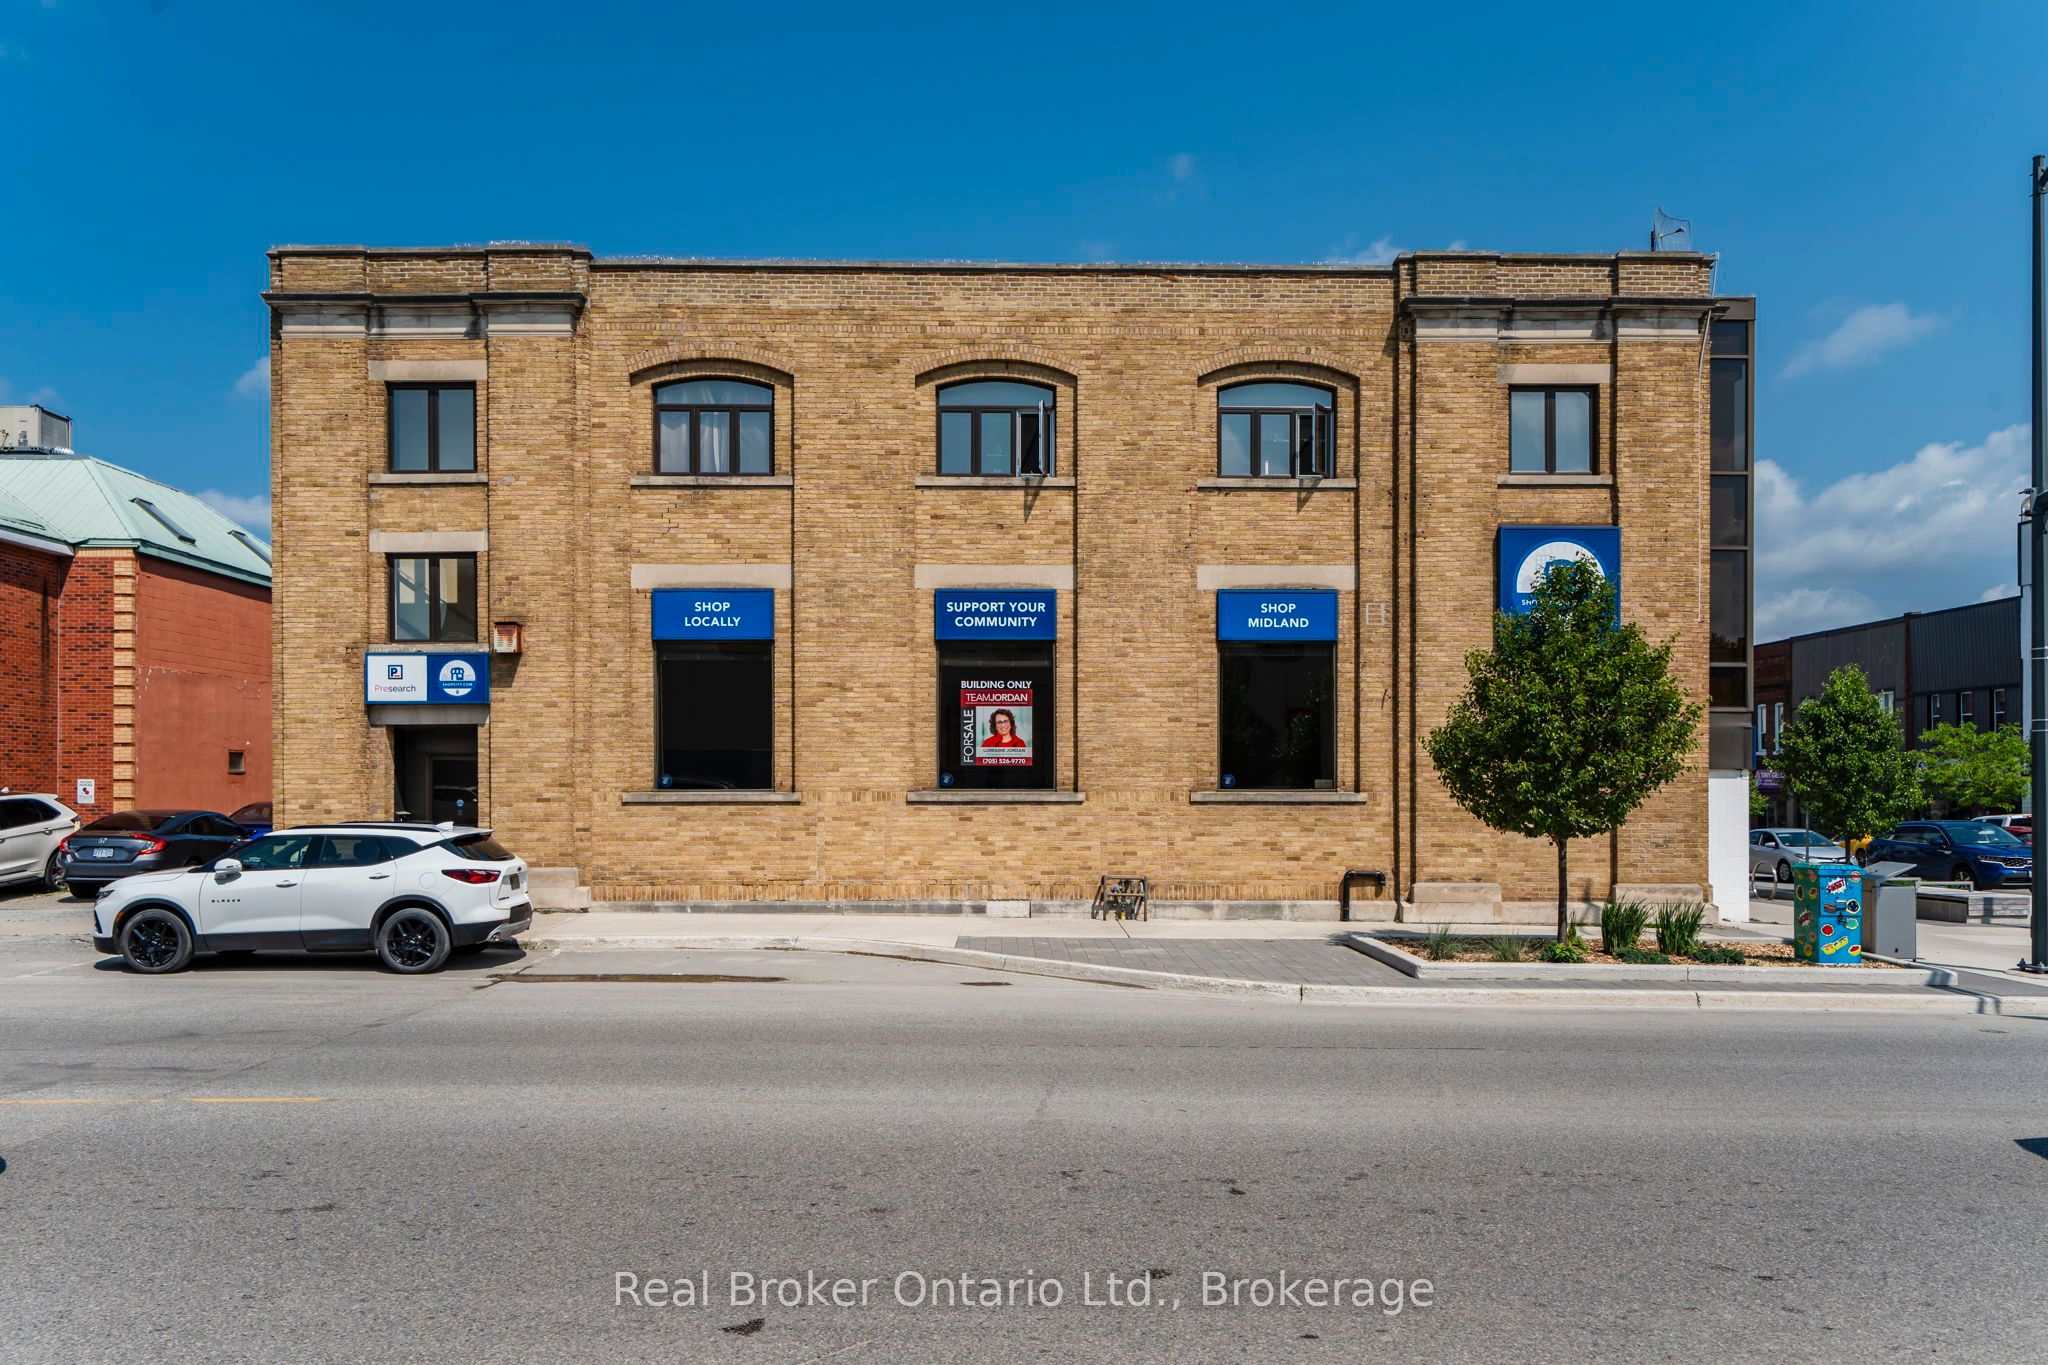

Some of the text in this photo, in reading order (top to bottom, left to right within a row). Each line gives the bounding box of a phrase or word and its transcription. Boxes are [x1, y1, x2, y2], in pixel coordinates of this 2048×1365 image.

[694, 601, 731, 612] SHOP
[946, 602, 1046, 612] SUPPORT YOUR
[1260, 603, 1296, 614] SHOP
[684, 616, 741, 627] LOCALLY
[954, 616, 1037, 627] COMMUNITY
[1248, 618, 1310, 628] MIDLAND
[374, 684, 416, 692] Presearch
[961, 680, 1032, 689] BUILDING ONLY
[966, 694, 1028, 702] TEAMJORDAN
